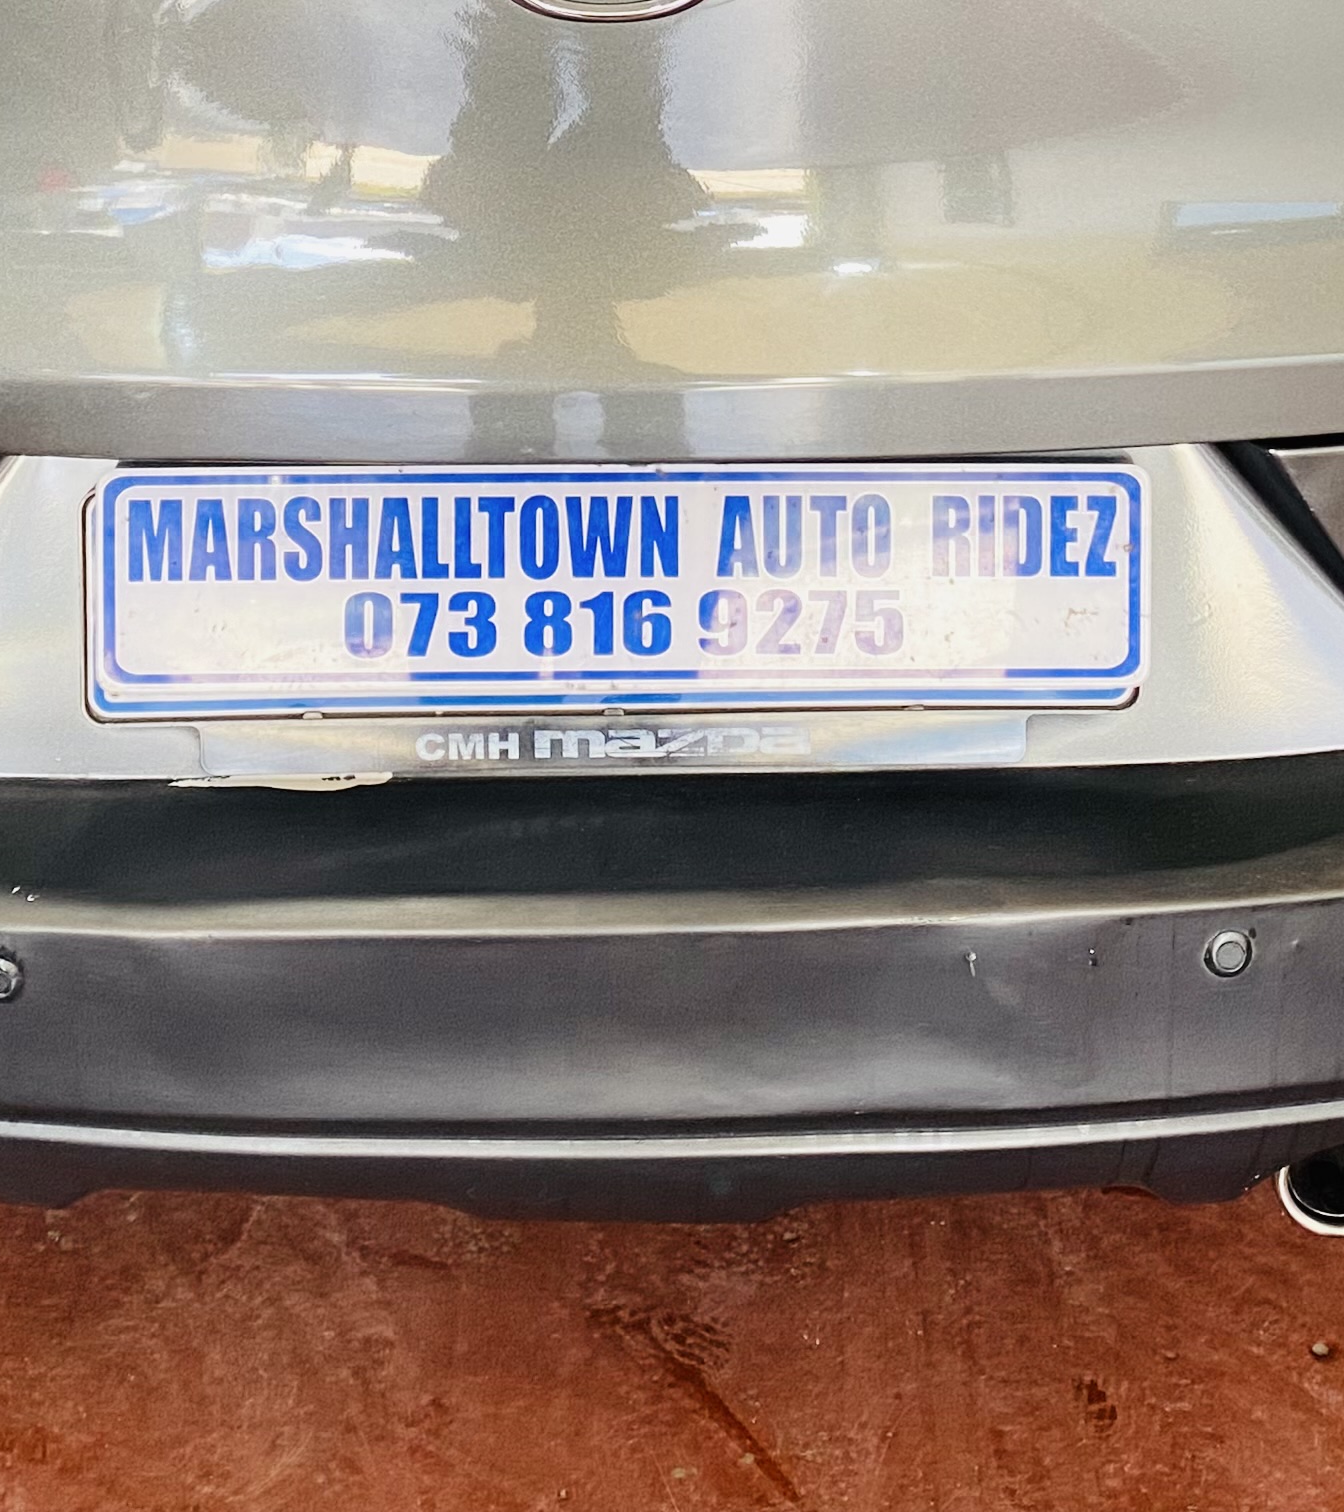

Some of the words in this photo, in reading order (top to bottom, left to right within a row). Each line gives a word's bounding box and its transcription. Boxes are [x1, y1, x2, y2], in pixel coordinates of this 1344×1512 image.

[128, 495, 679, 582] MARSHALLTOWN
[716, 493, 892, 579] AUTO
[931, 494, 1117, 578] RIDEZ
[344, 591, 497, 658] 073
[524, 590, 672, 657] 816
[698, 589, 904, 656] 9275
[415, 732, 520, 761] CMH
